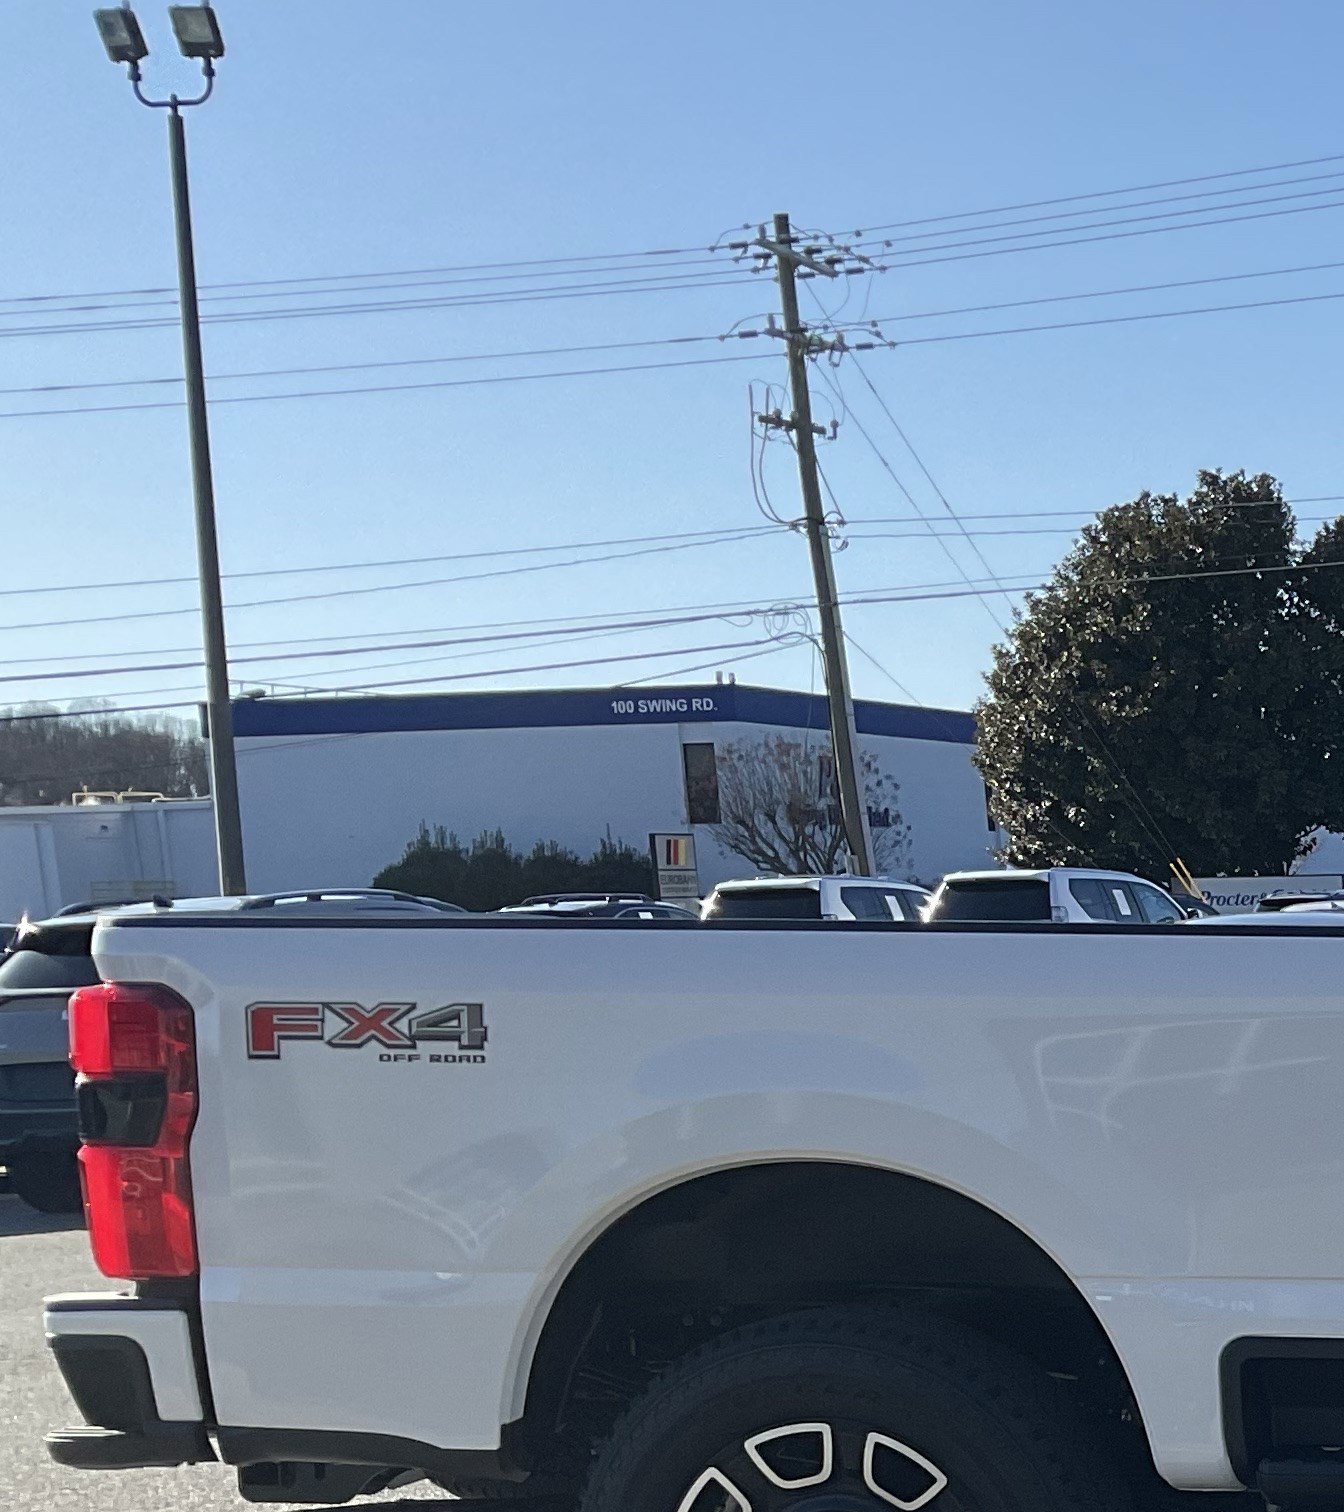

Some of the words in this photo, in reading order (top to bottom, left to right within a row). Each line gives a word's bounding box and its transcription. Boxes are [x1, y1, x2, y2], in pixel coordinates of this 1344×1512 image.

[611, 700, 635, 714] 100
[637, 699, 688, 713] SWING
[691, 698, 718, 711] RD.
[245, 1001, 488, 1060] FX4
[378, 1053, 421, 1063] OFF
[429, 1053, 487, 1064] ROAD
